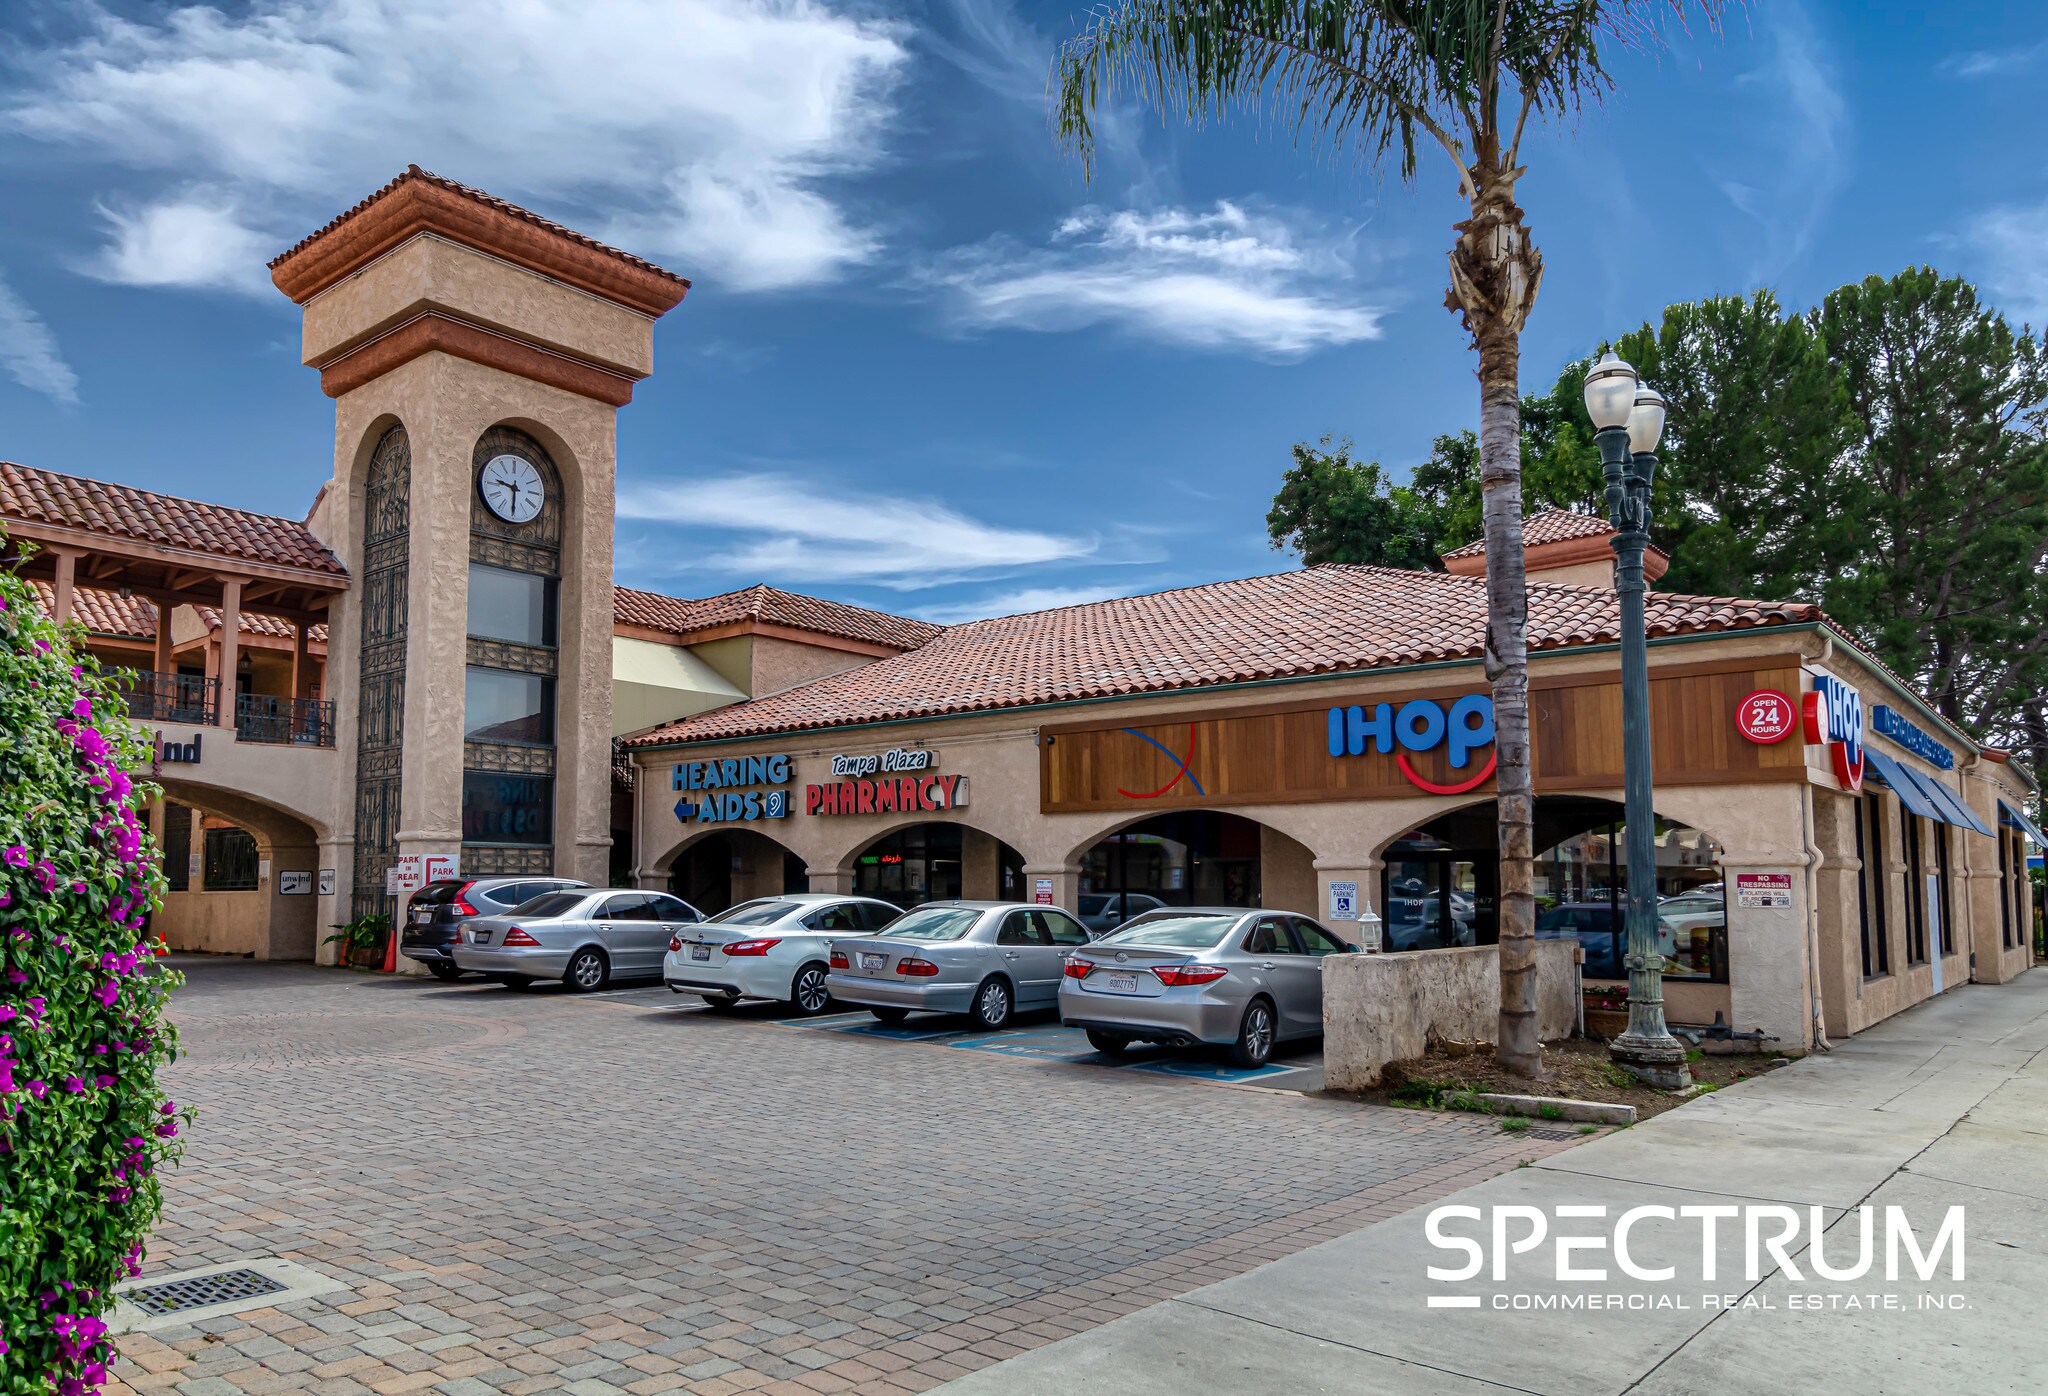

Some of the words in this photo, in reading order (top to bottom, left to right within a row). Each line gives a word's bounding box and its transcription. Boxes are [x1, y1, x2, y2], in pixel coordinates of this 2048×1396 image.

[1753, 699, 1777, 708] OPEN
[1751, 707, 1780, 726] 24
[1826, 675, 1863, 765] IHOP
[1328, 694, 1496, 768] IHOP
[1750, 725, 1781, 734] HOURS
[831, 753, 878, 777] Tampa
[884, 748, 929, 773] Plaza
[672, 754, 791, 791] HEARING
[806, 774, 958, 816] PHARMACY
[697, 791, 762, 823] AIDS
[432, 867, 454, 875] PARK
[1331, 883, 1356, 891] RESERVED
[1333, 890, 1354, 898] PARKING
[1404, 899, 1424, 907] IHOP
